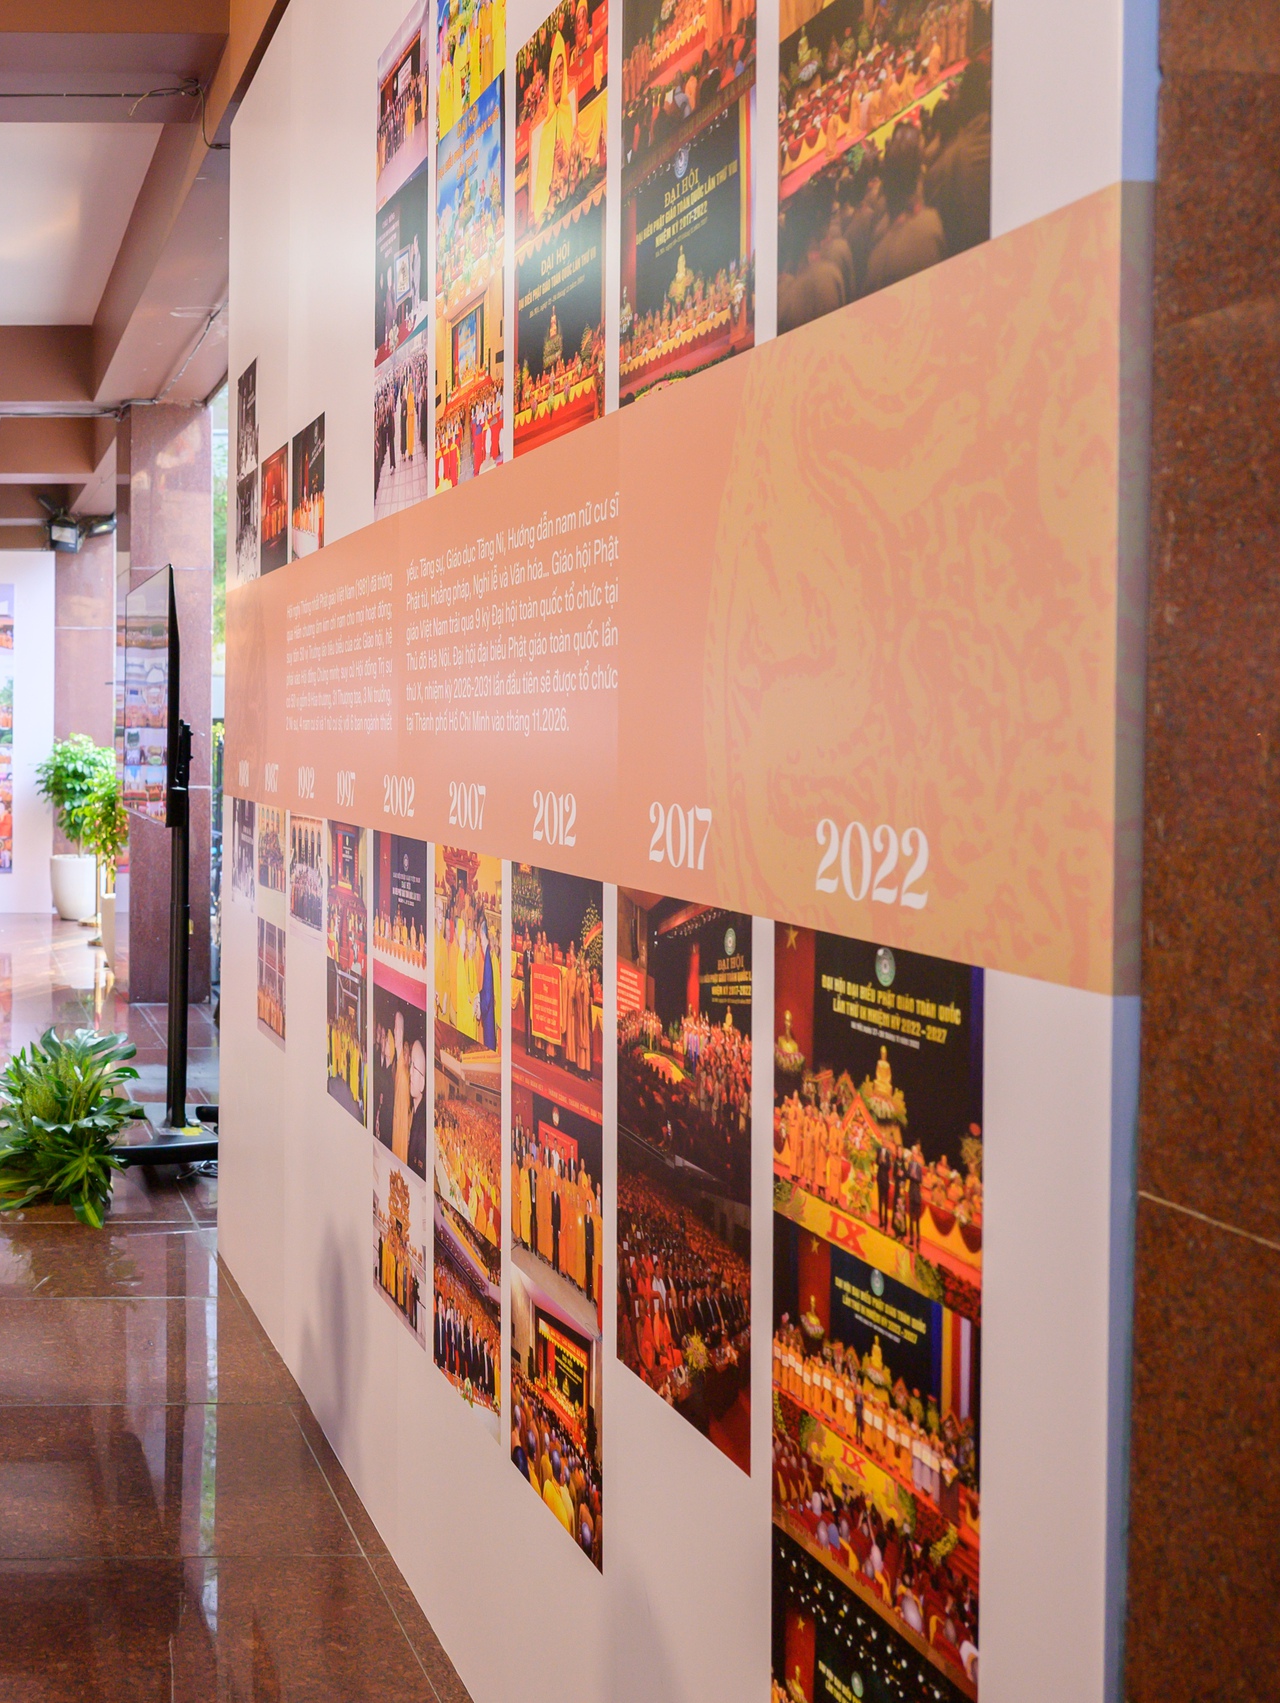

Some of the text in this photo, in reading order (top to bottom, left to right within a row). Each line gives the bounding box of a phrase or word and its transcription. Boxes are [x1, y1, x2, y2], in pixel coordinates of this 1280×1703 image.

[664, 168, 699, 208] ĐẠI HỘI
[420, 557, 434, 579] Tăng
[446, 547, 461, 569] Giáo
[463, 544, 476, 567] dục
[477, 537, 494, 561] Tăng
[496, 531, 506, 556] Ni,
[508, 524, 534, 549] Hướng
[536, 510, 553, 541] dẫn
[556, 512, 576, 535] nam
[579, 501, 592, 528] nữ
[594, 498, 607, 523] cư
[610, 491, 619, 518] sĩ
[406, 591, 420, 614] Phật
[453, 578, 471, 602] pháp,
[473, 571, 489, 599] Nghi
[500, 566, 508, 588] và
[510, 562, 525, 585] Văn
[552, 548, 573, 575] Giáo
[576, 542, 591, 573] hội
[594, 535, 619, 567] Phật
[406, 622, 419, 646] giáo
[420, 619, 432, 642] Việt
[433, 617, 447, 635] Nam
[461, 614, 474, 636] qua
[482, 606, 490, 632] kỳ
[492, 602, 504, 629] Đại
[506, 600, 517, 627] hội
[519, 596, 538, 620] toàn
[540, 586, 562, 621] quốc
[565, 581, 575, 611] tổ
[577, 582, 602, 609] chức
[605, 577, 618, 609] tại
[406, 651, 418, 671] Thủ
[428, 649, 437, 669] Hà
[439, 647, 451, 671] Nội.
[453, 645, 464, 669] Đại
[465, 643, 475, 668] hội
[477, 641, 488, 667] đại
[490, 634, 506, 661] biểu
[508, 635, 526, 662] Phật
[528, 632, 547, 662] giáo
[550, 628, 570, 653] toàn
[573, 619, 598, 656] quốc
[602, 617, 618, 647] lần
[424, 680, 443, 703] nhiệm
[444, 679, 452, 703] kỳ
[454, 675, 491, 698] 2026-2031
[493, 671, 504, 696] lần
[506, 669, 520, 695] đầu
[522, 671, 538, 694] tiên
[540, 670, 550, 693] sẽ
[553, 669, 576, 697] được
[579, 660, 589, 690] tổ
[591, 664, 618, 690] chức
[415, 712, 434, 731] Thành
[435, 708, 447, 735] phố
[449, 708, 458, 731] Hồ
[460, 711, 471, 731] Chí
[472, 710, 489, 731] Minh
[492, 710, 504, 731] vào
[506, 709, 530, 737] tháng
[532, 707, 569, 731] 11.2026.
[264, 762, 279, 793] 1987
[298, 765, 315, 799] 1992
[336, 770, 356, 807] 1997
[383, 774, 415, 818] 2002
[449, 781, 486, 830] 2007
[532, 789, 577, 847] 2012
[648, 801, 713, 871] 2017
[815, 818, 930, 910] 2022
[826, 1210, 868, 1260] IX
[840, 1443, 867, 1481] IX
